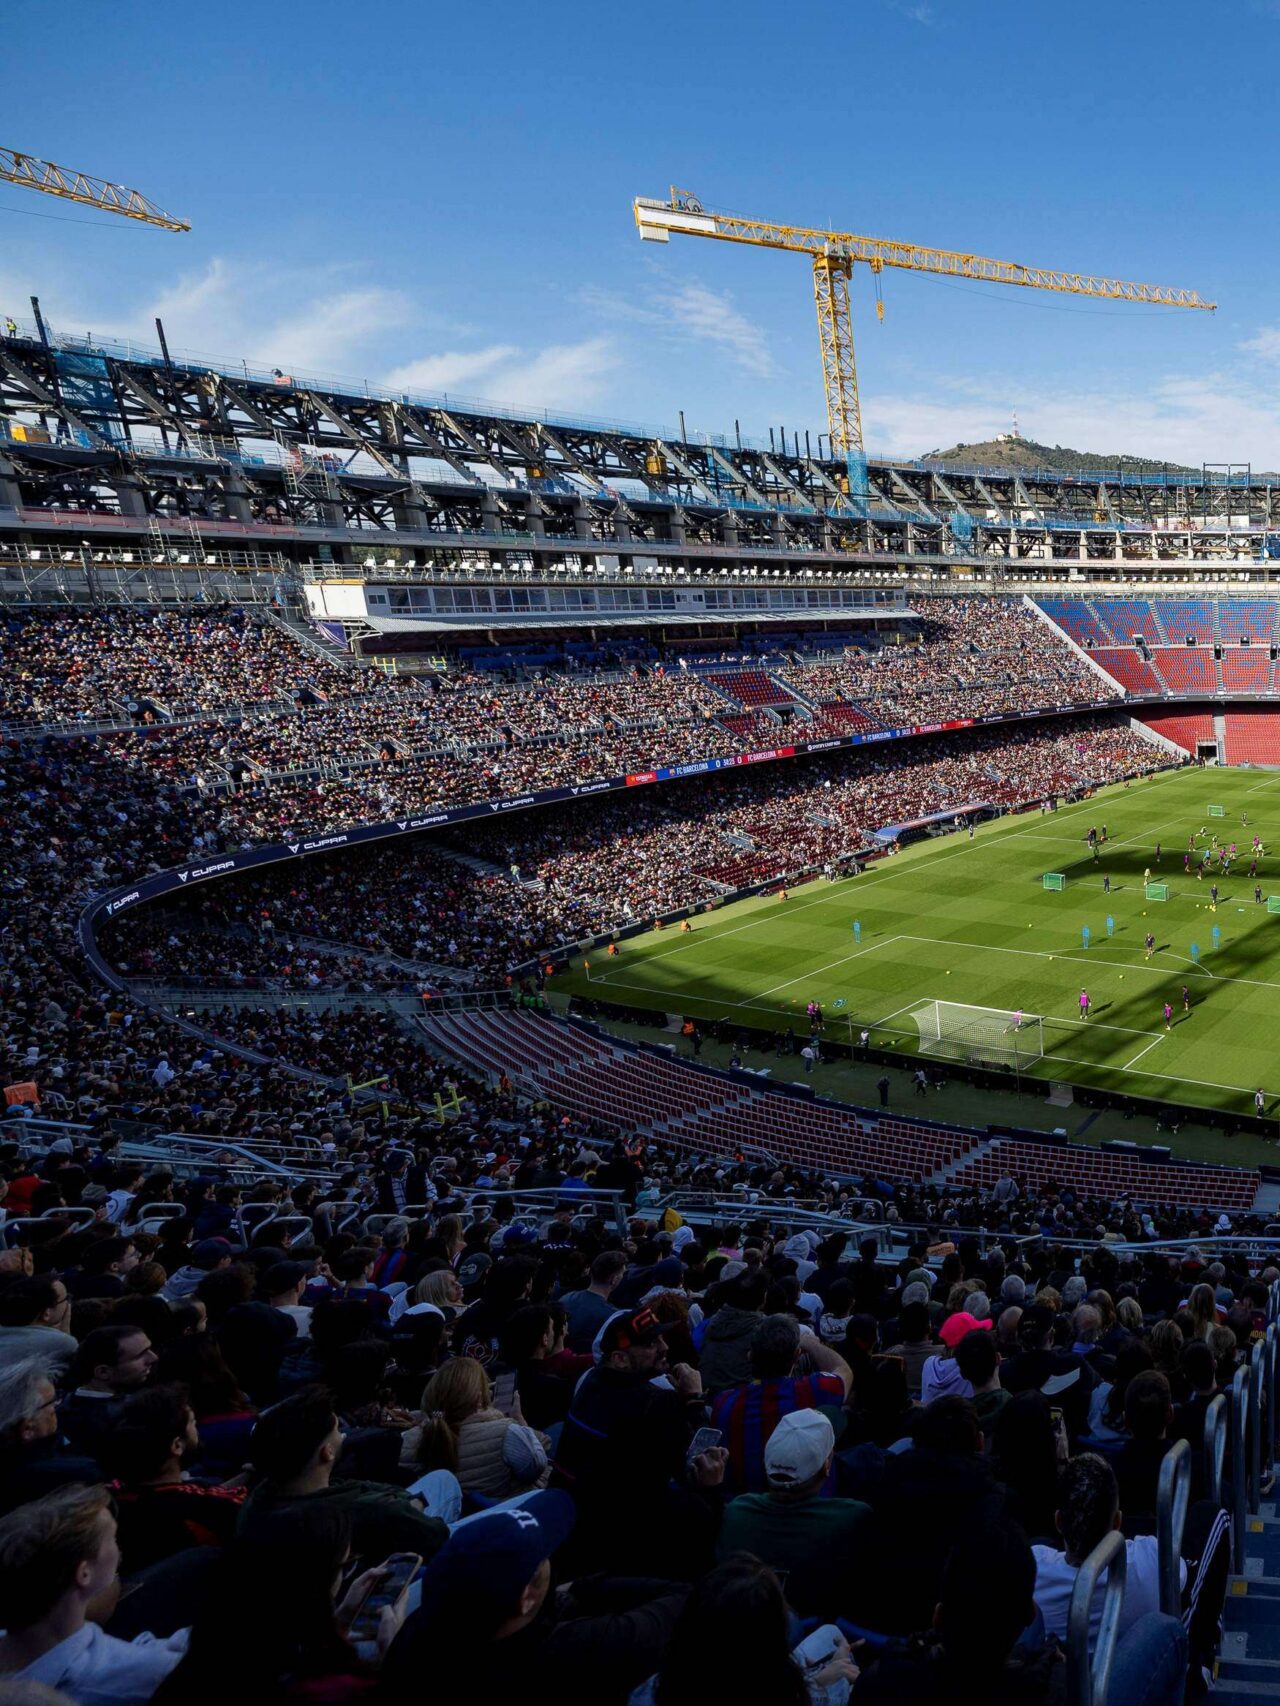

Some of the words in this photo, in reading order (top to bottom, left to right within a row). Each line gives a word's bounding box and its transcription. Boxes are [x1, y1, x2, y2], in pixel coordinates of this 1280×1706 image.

[683, 763, 708, 774] BARCELONA
[716, 760, 720, 768] 0
[753, 751, 776, 760] BARCELONA
[581, 782, 610, 792] CUPRA
[502, 798, 534, 808] CUPRA
[411, 814, 448, 827] CUPRA
[304, 835, 347, 850] CUPRA
[192, 861, 234, 877] CUPRA
[113, 891, 139, 910] CUPRA
